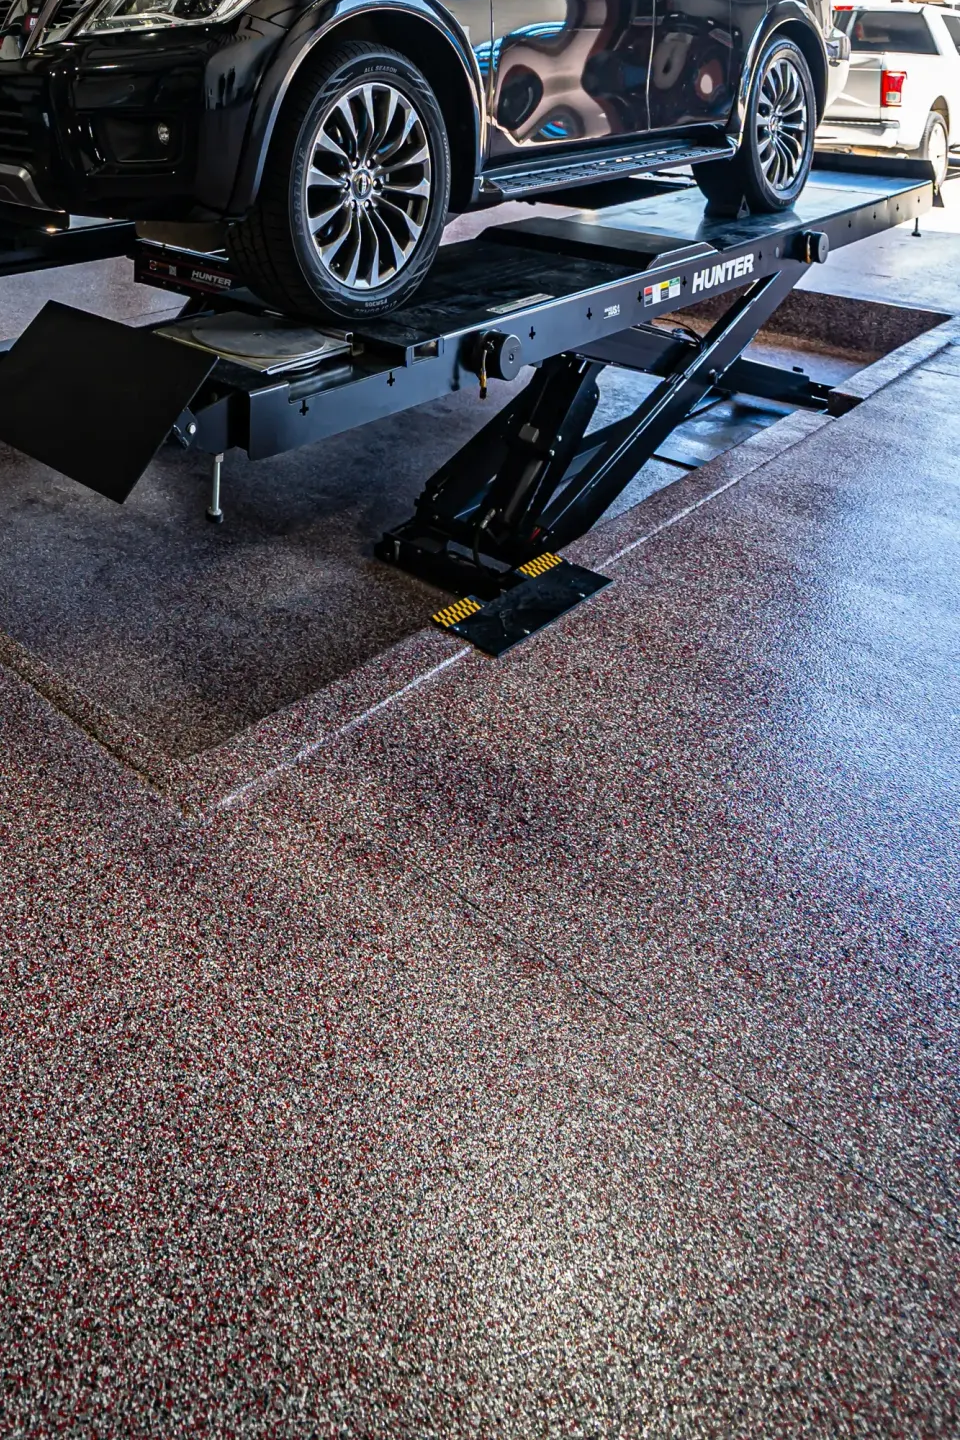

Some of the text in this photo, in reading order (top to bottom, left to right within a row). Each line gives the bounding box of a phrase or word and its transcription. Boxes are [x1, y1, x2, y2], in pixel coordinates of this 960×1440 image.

[364, 64, 398, 74] ALL SEASON
[191, 270, 232, 287] HUNTER
[692, 253, 755, 295] HUNTER
